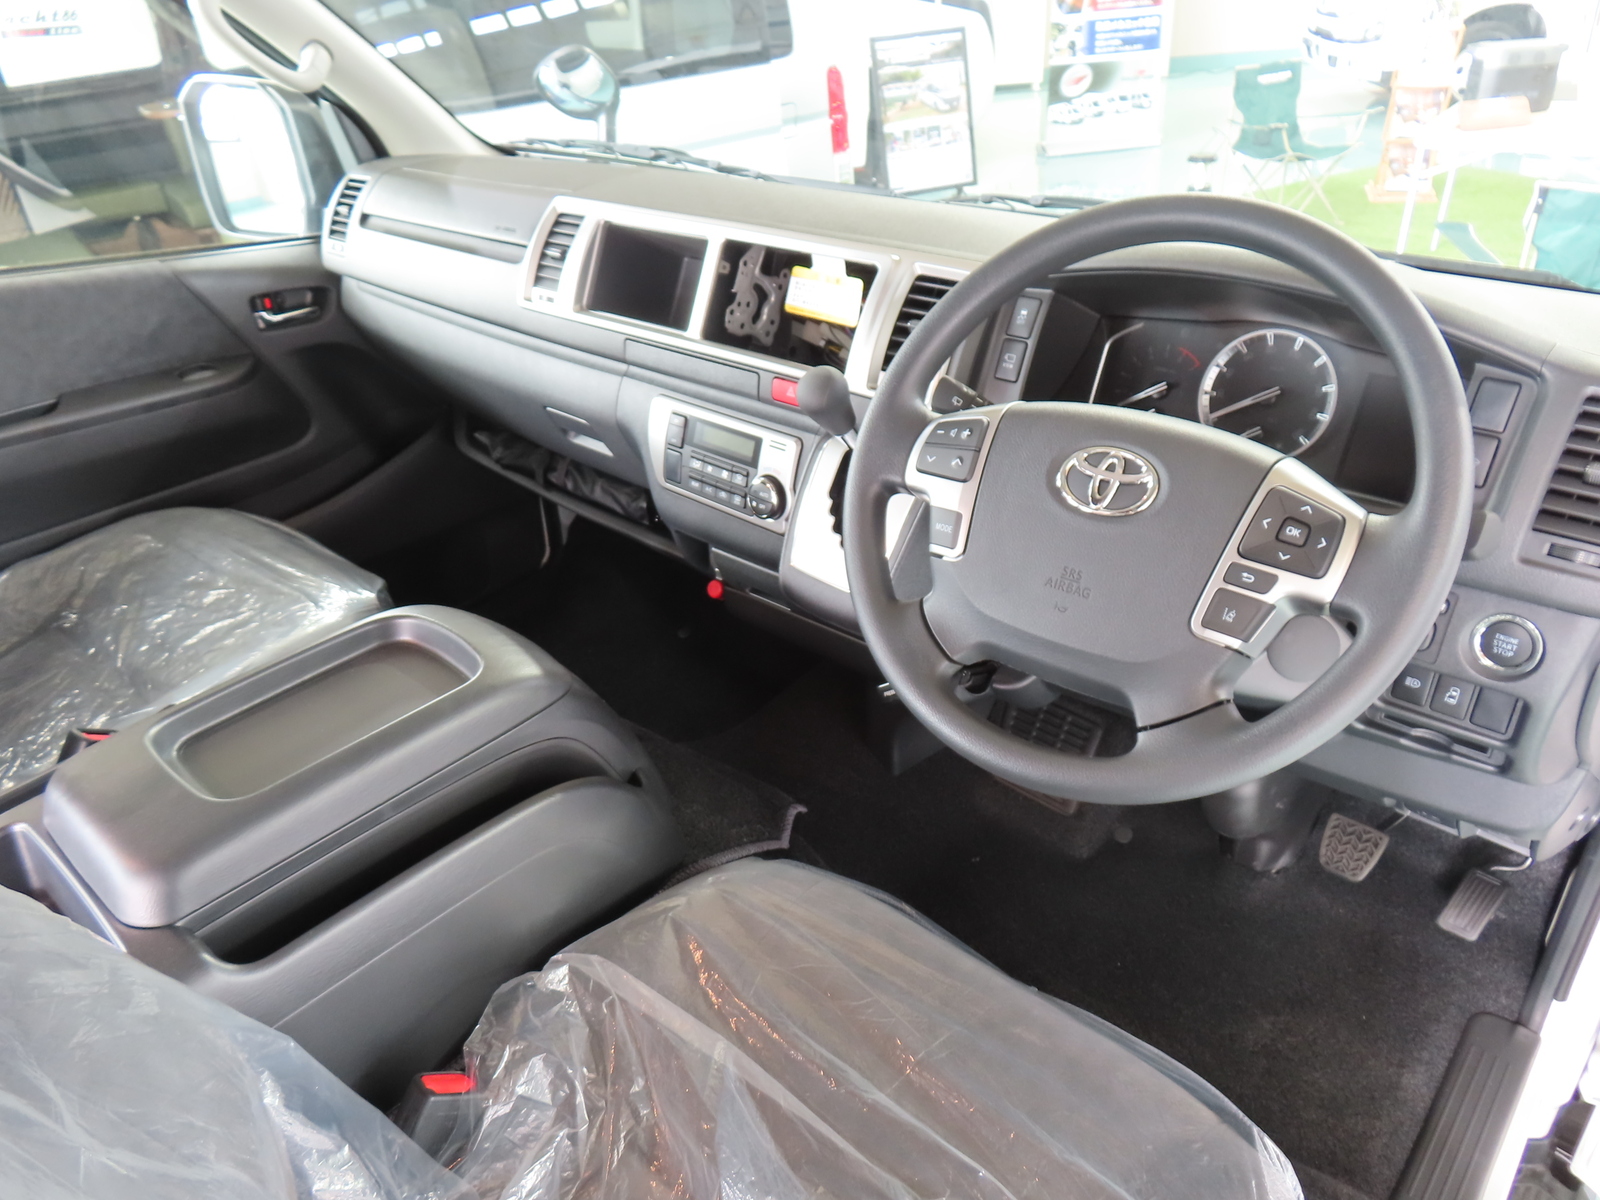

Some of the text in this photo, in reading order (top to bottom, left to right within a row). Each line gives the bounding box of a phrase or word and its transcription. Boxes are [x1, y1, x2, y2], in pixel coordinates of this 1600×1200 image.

[935, 522, 953, 533] MODE
[1285, 525, 1302, 538] OK
[1061, 565, 1083, 581] SRS
[1045, 576, 1092, 600] AIRBAG
[1495, 632, 1519, 645] ENGINE
[1492, 646, 1515, 658] STOP
[1493, 639, 1518, 652] START
